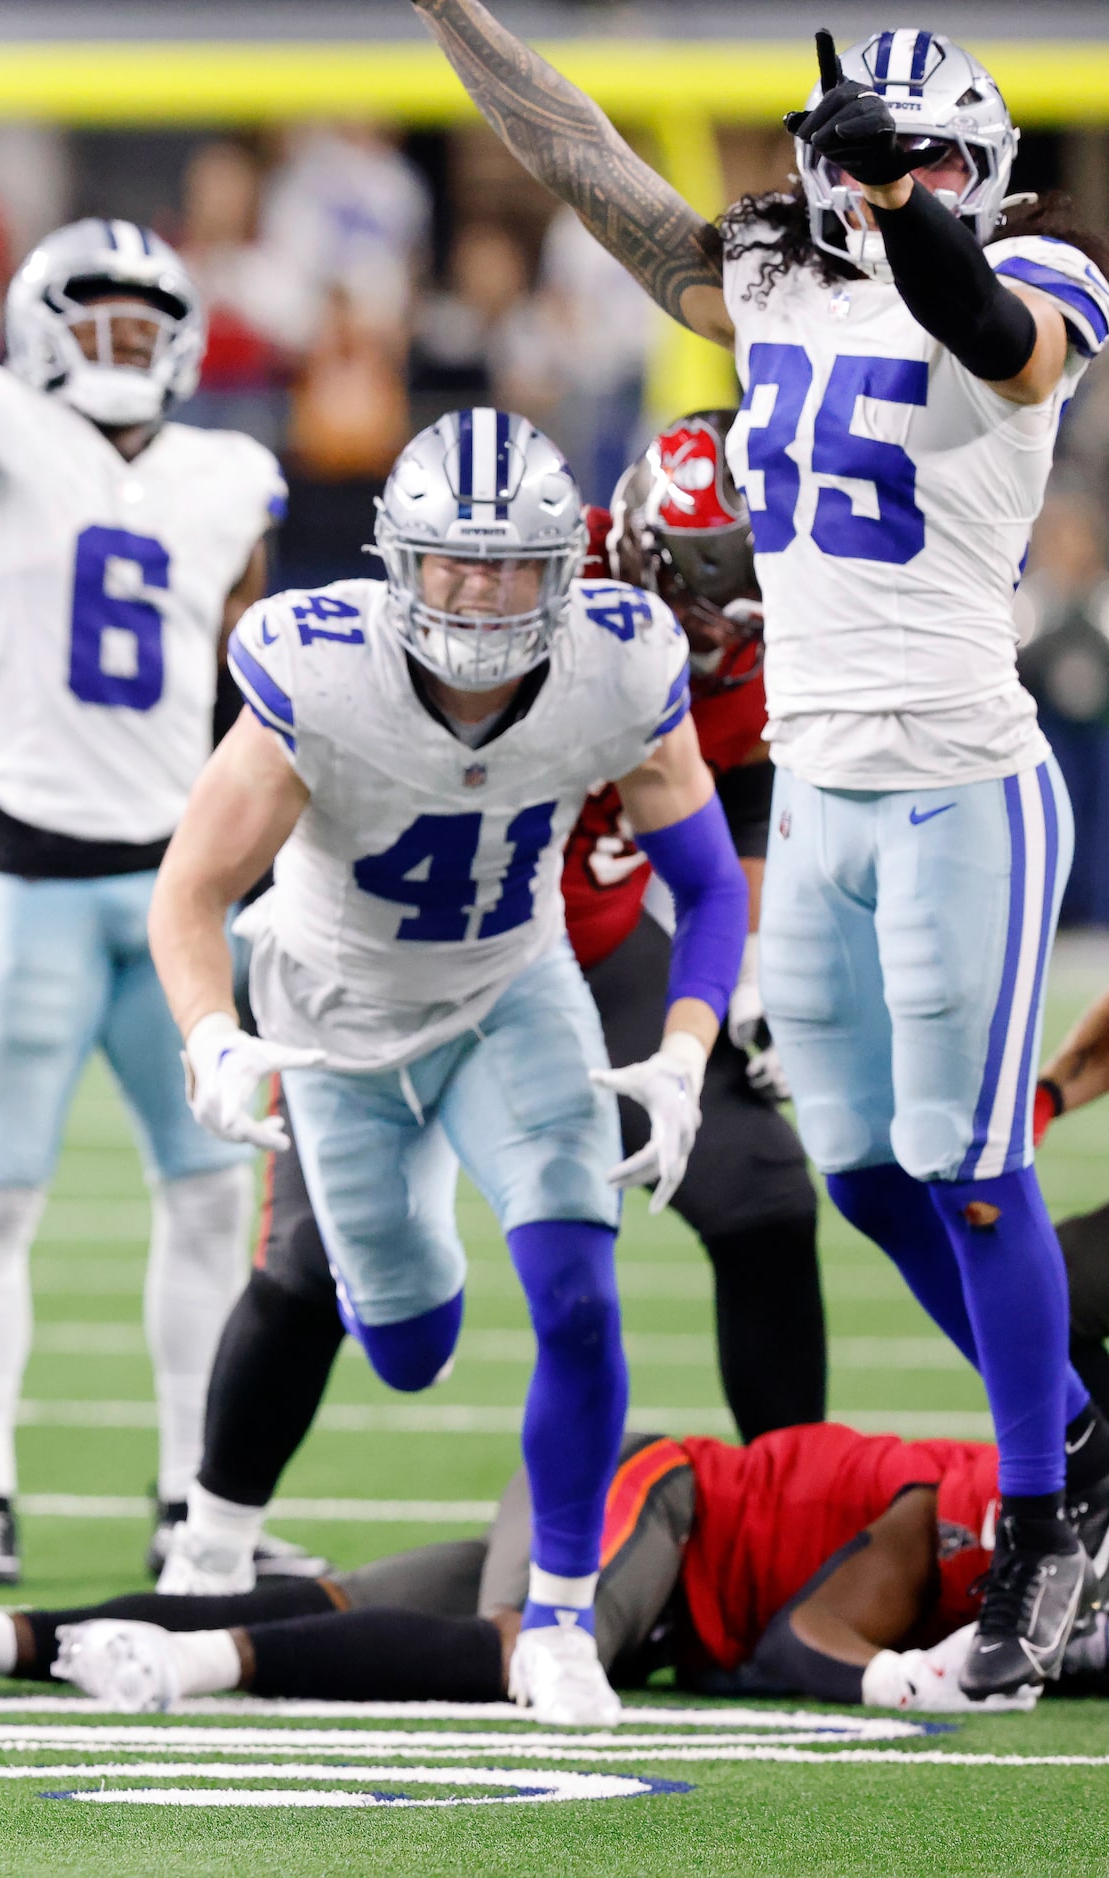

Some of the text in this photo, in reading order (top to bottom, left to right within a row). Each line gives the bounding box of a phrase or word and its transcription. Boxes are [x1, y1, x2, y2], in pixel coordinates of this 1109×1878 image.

[739, 343, 929, 565] 35
[68, 526, 170, 711] 6
[292, 596, 365, 646] 41
[354, 802, 558, 942] 41
